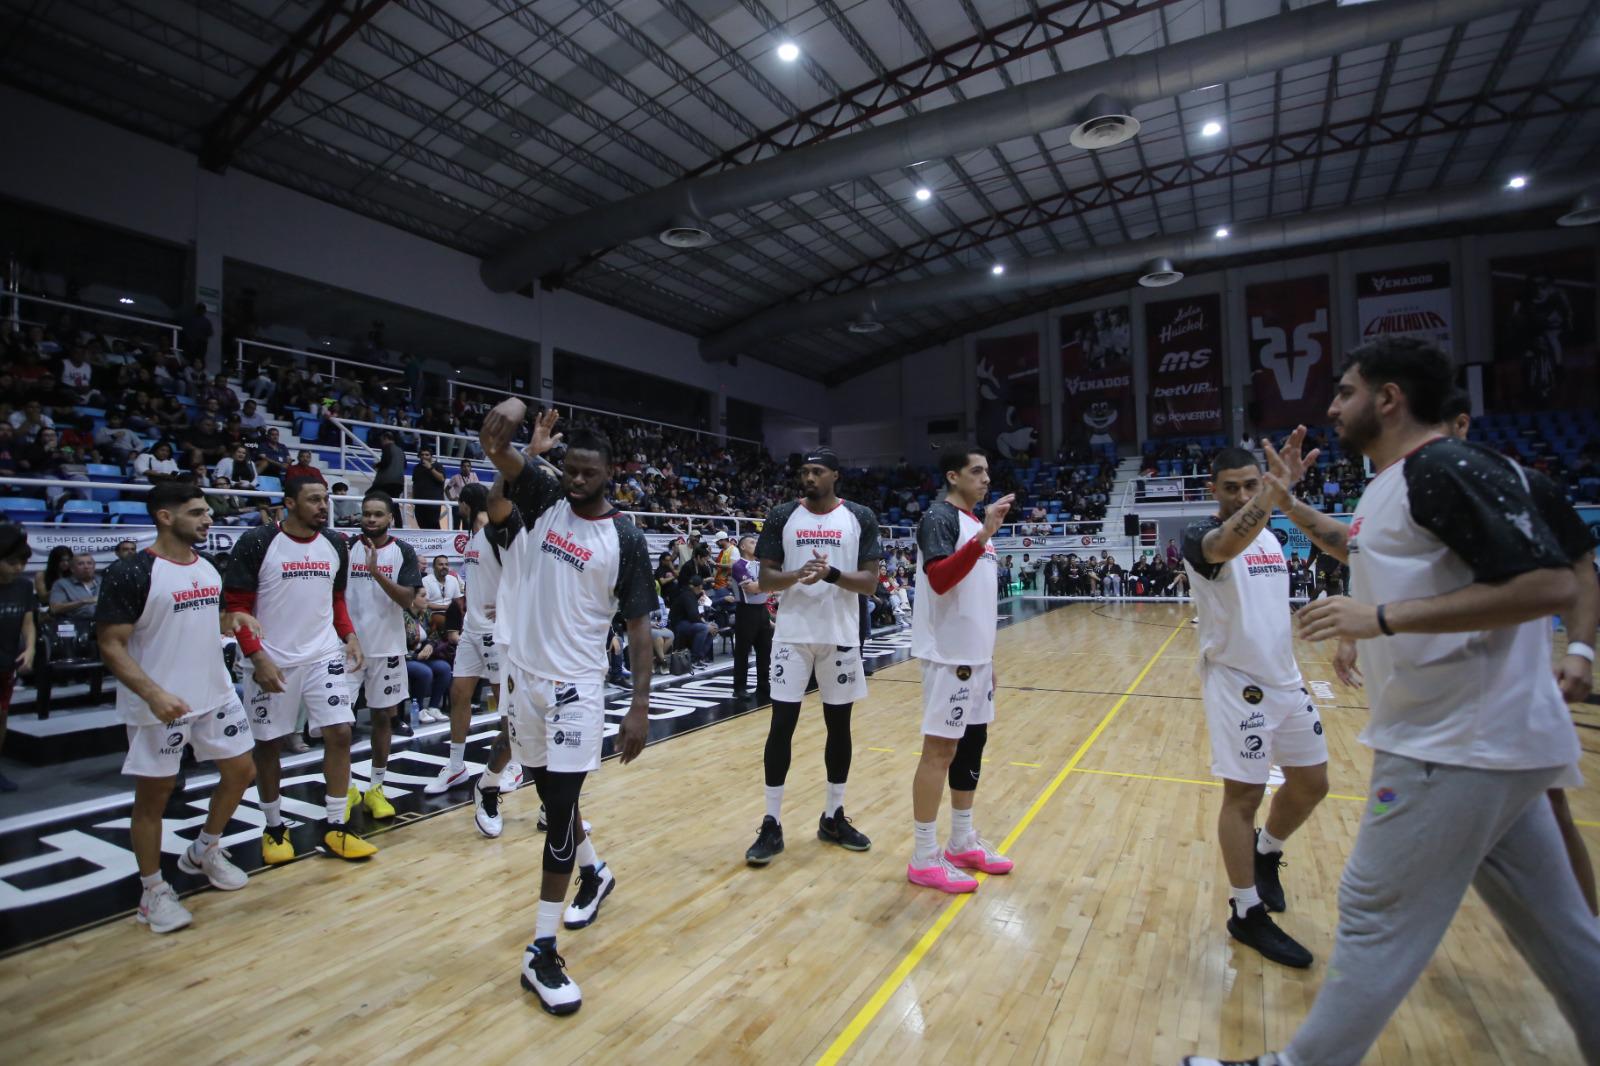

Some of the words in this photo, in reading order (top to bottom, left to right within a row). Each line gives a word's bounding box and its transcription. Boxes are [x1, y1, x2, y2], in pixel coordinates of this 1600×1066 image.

[1372, 274, 1433, 291] VENADOS
[1065, 375, 1130, 395] VENADOS
[36, 536, 85, 544] SIEMPRE
[796, 530, 842, 539] VENADOS
[546, 529, 592, 562] VENADOS
[796, 539, 841, 547] BASKETBALL
[1244, 553, 1284, 566] VENADOS
[282, 561, 331, 571] VENADOS
[1248, 564, 1287, 575] BASKETBALL
[282, 570, 330, 579] BASKETBALL
[172, 586, 220, 603] VENADOS
[173, 597, 221, 611] BASKETBALL
[1240, 750, 1265, 759] MEGA
